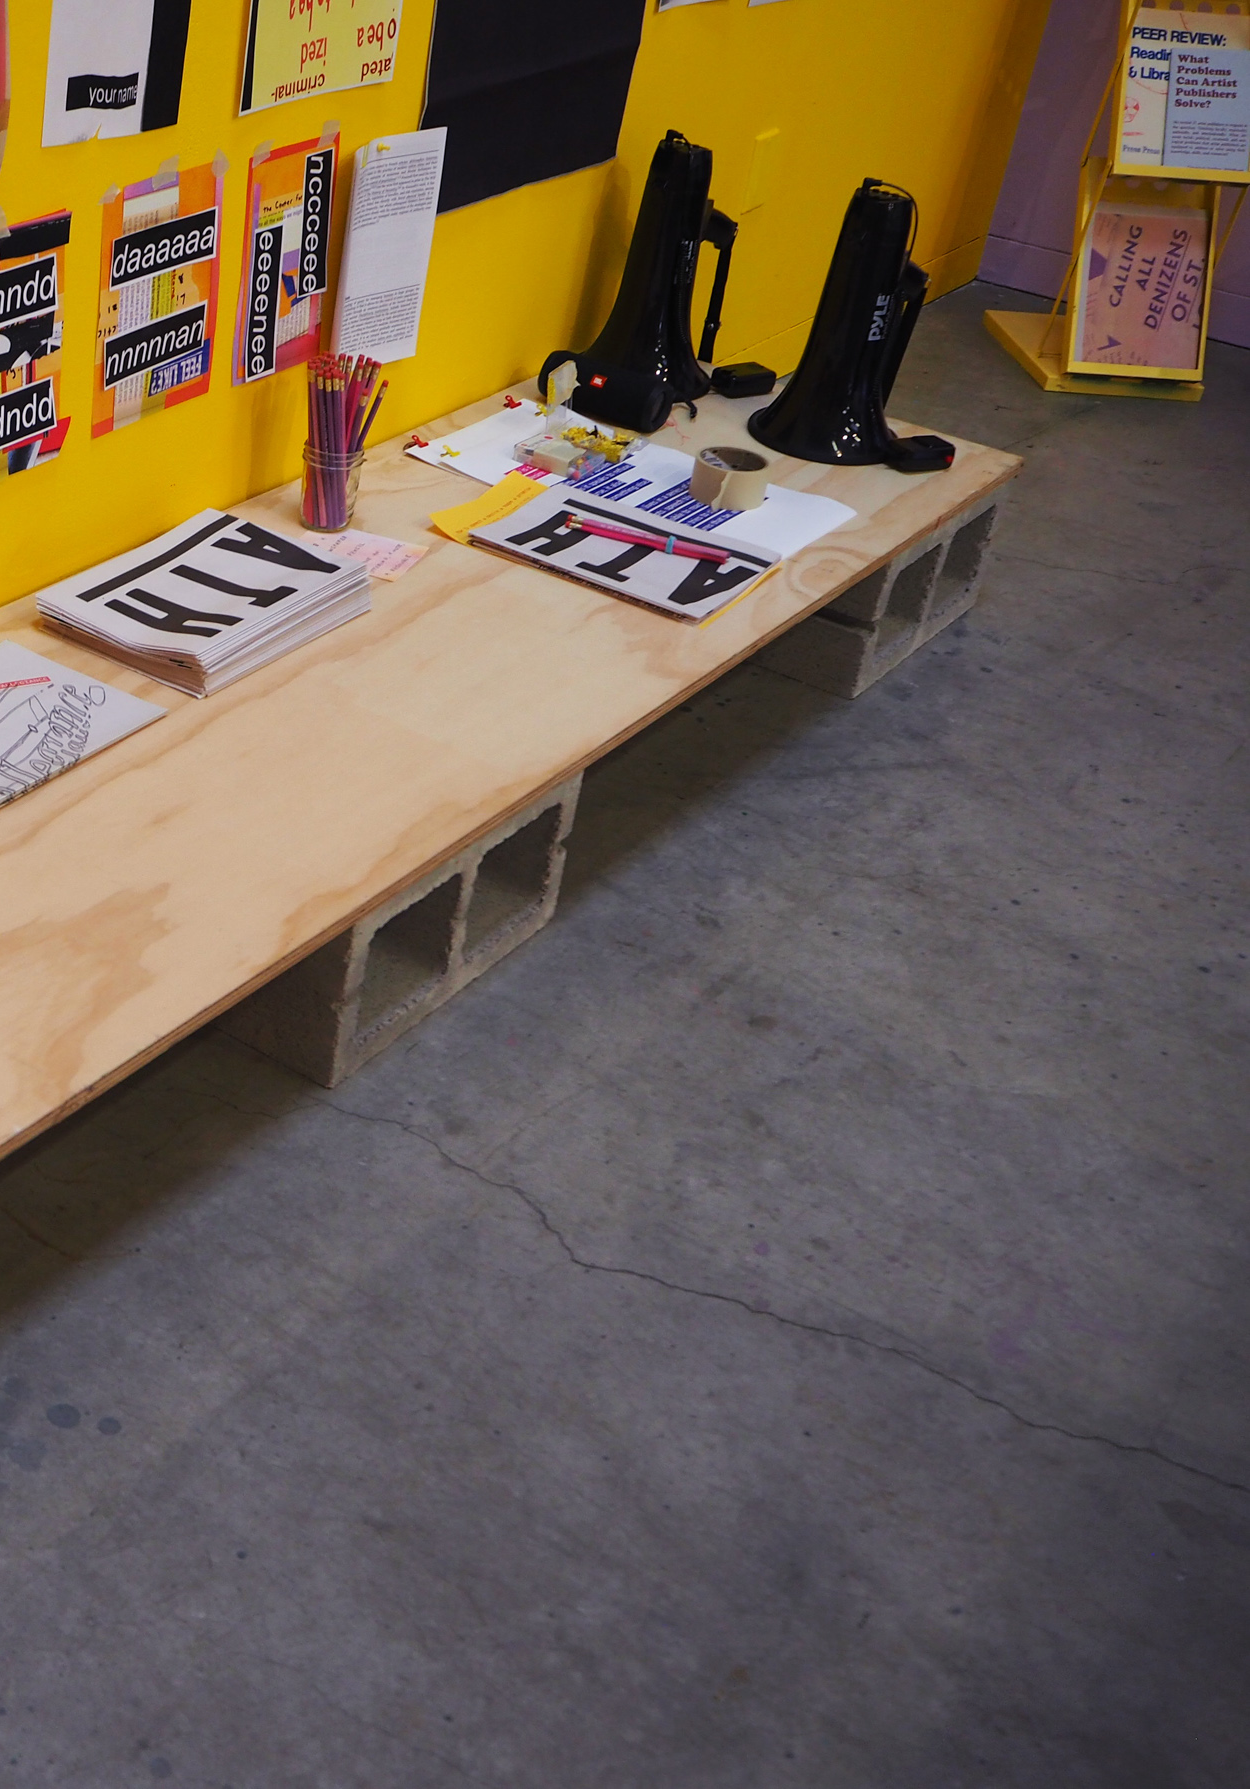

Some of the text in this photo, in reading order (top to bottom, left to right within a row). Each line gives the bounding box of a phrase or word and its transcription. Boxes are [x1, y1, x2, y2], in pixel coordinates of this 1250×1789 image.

[357, 26, 365, 48] a
[367, 21, 384, 51] be
[1132, 27, 1227, 47] PEER REVIEW:
[300, 37, 328, 74] ized
[1178, 54, 1209, 64] What
[1128, 66, 1170, 81] & Libra
[1176, 77, 1238, 88] Can Artist
[1177, 66, 1231, 76] Problems
[89, 84, 137, 106] your name
[271, 73, 325, 102] criminal-
[1175, 88, 1237, 99] Publishers
[1174, 99, 1212, 109] Solve?
[302, 156, 324, 292] nccceee
[113, 226, 214, 278] daaaaaa
[1109, 224, 1143, 307] CALLING
[1135, 256, 1156, 291] ALL
[1144, 228, 1188, 329] DENIZENS
[251, 231, 273, 374] eeeenee
[867, 294, 891, 341] PYLE
[1172, 291, 1191, 322] OF
[106, 319, 203, 379] nnnnnan
